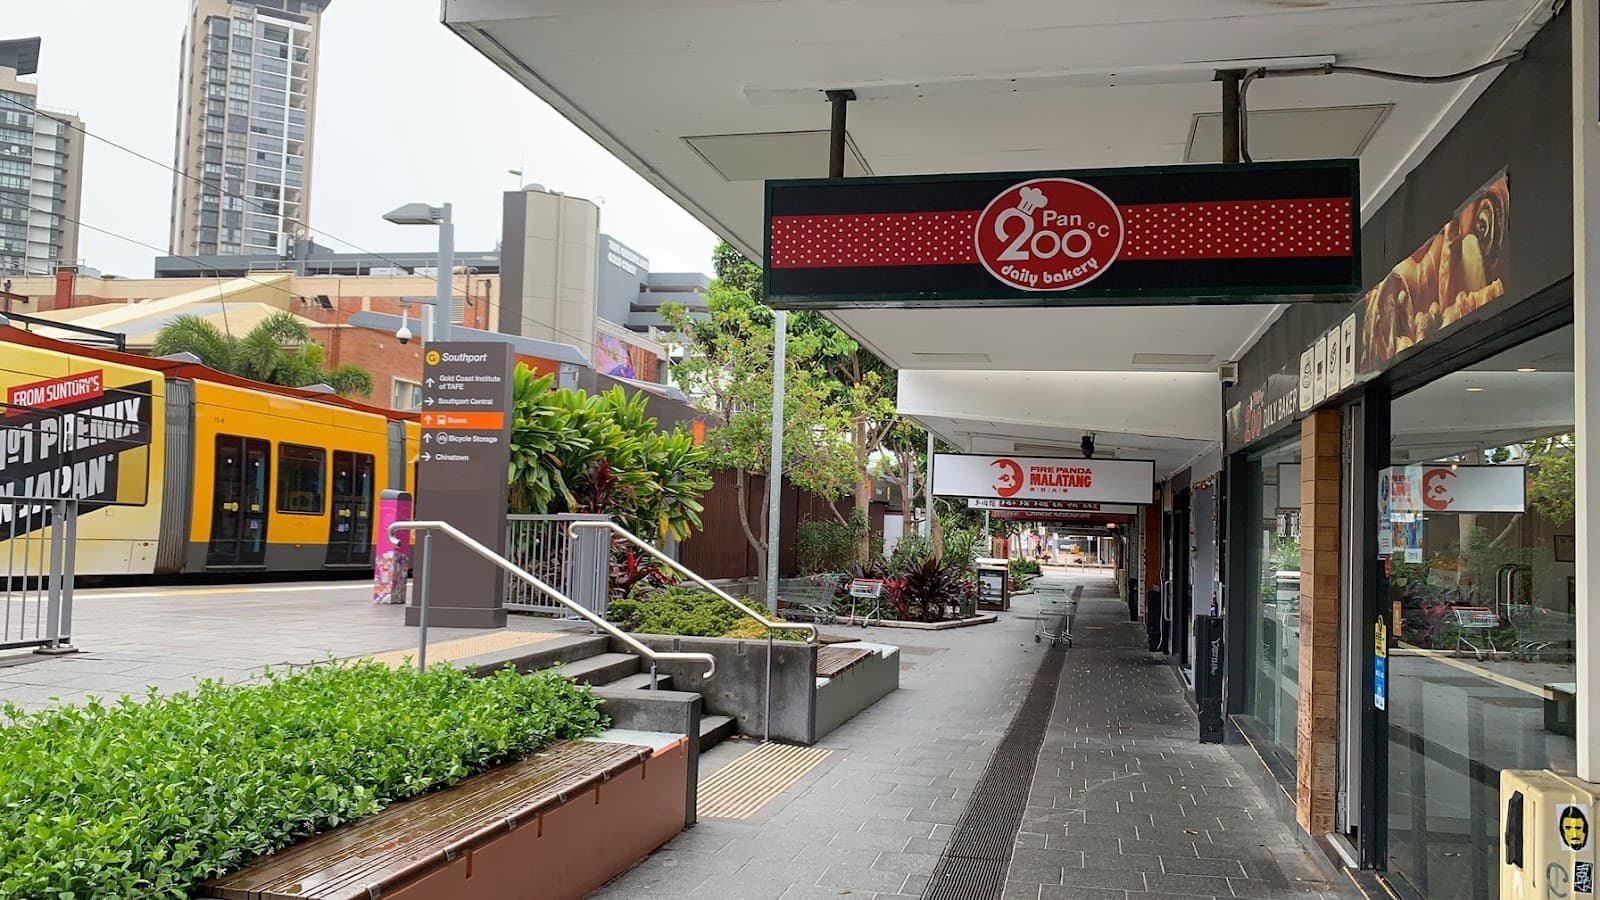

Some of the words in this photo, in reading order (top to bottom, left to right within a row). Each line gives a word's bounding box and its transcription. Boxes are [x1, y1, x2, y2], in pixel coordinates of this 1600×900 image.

[1042, 210, 1082, 227] Pan
[994, 207, 1092, 262] 200
[1001, 264, 1038, 286] daily
[1043, 257, 1098, 284] bakery
[442, 352, 488, 363] Southport
[13, 386, 45, 407] FROM
[46, 375, 100, 402] SUNTORY'S
[1278, 387, 1298, 421] BAKER
[40, 397, 141, 460] PREMIX
[448, 435, 471, 443] Bicycle
[472, 435, 498, 443] Storage
[435, 453, 469, 461] Chinatown
[1030, 473, 1092, 487] MALATANG
